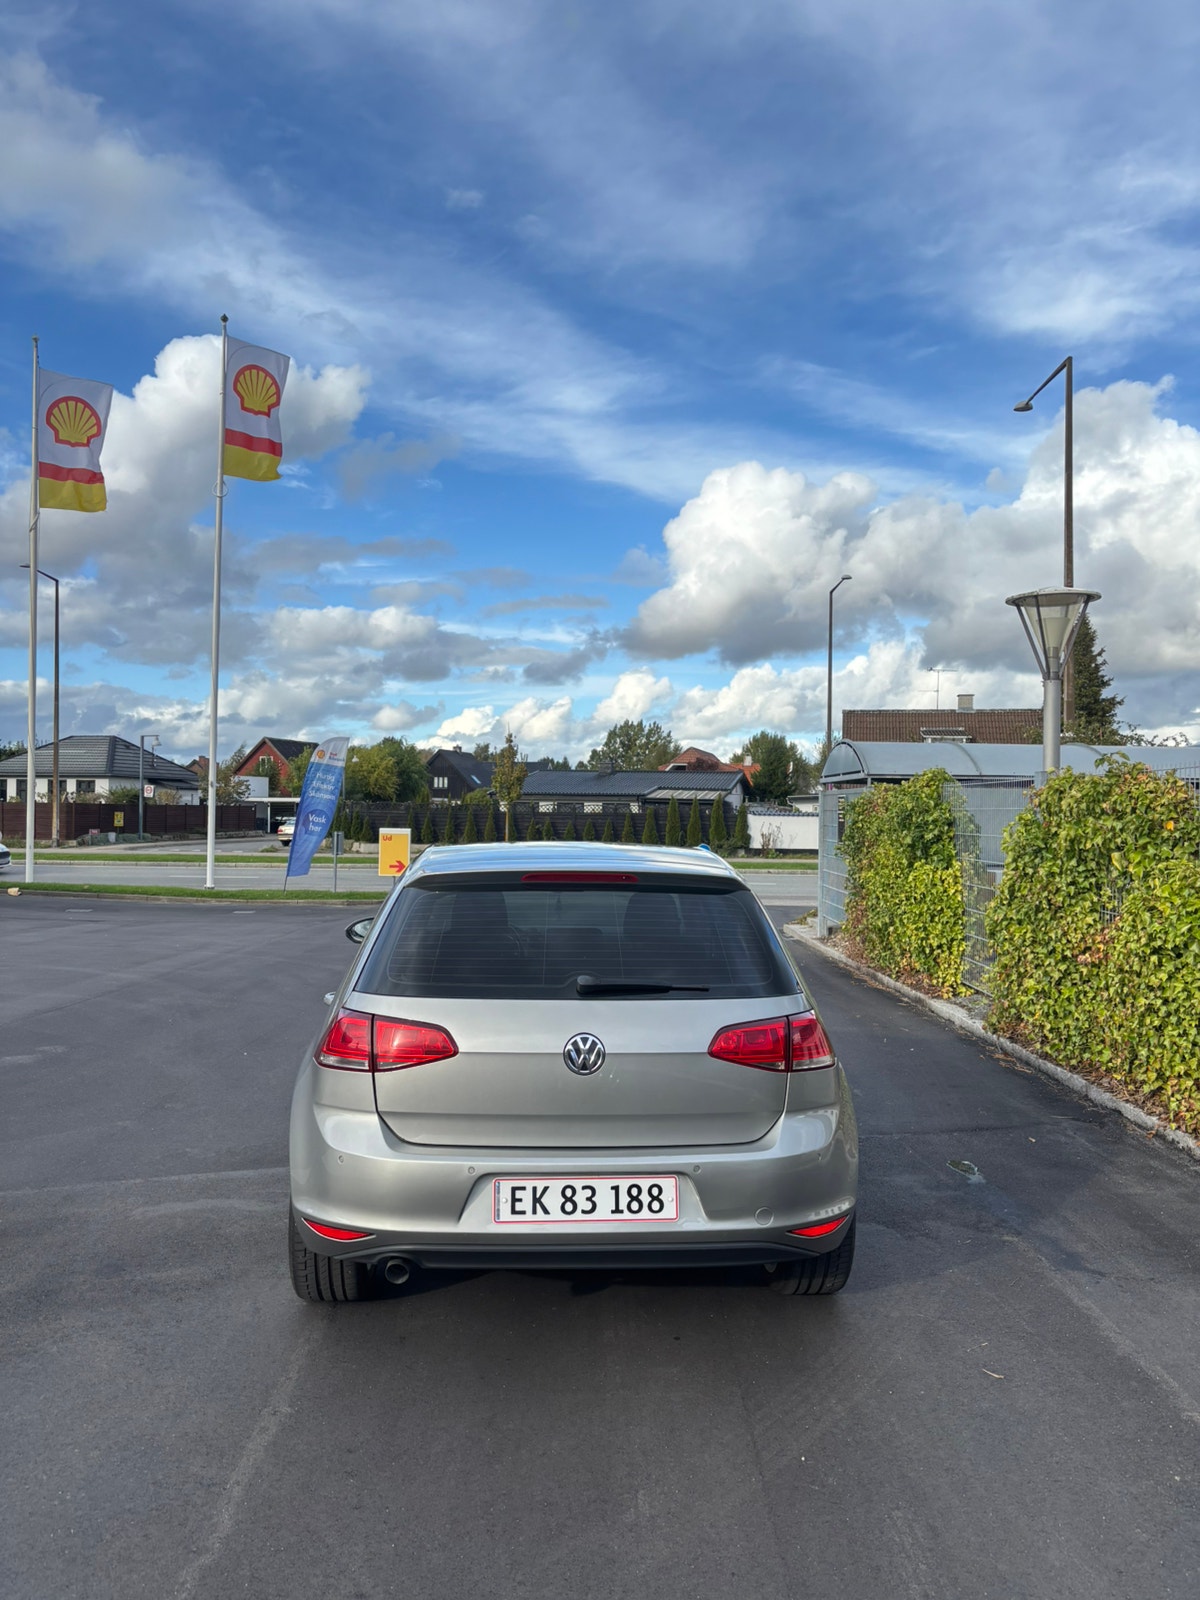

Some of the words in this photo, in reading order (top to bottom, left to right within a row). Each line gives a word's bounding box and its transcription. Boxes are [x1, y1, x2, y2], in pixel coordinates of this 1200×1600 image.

[308, 813, 326, 824] Vask
[308, 822, 322, 832] her
[510, 1186, 551, 1215] EK
[560, 1184, 597, 1215] 83
[610, 1183, 665, 1215] 188
